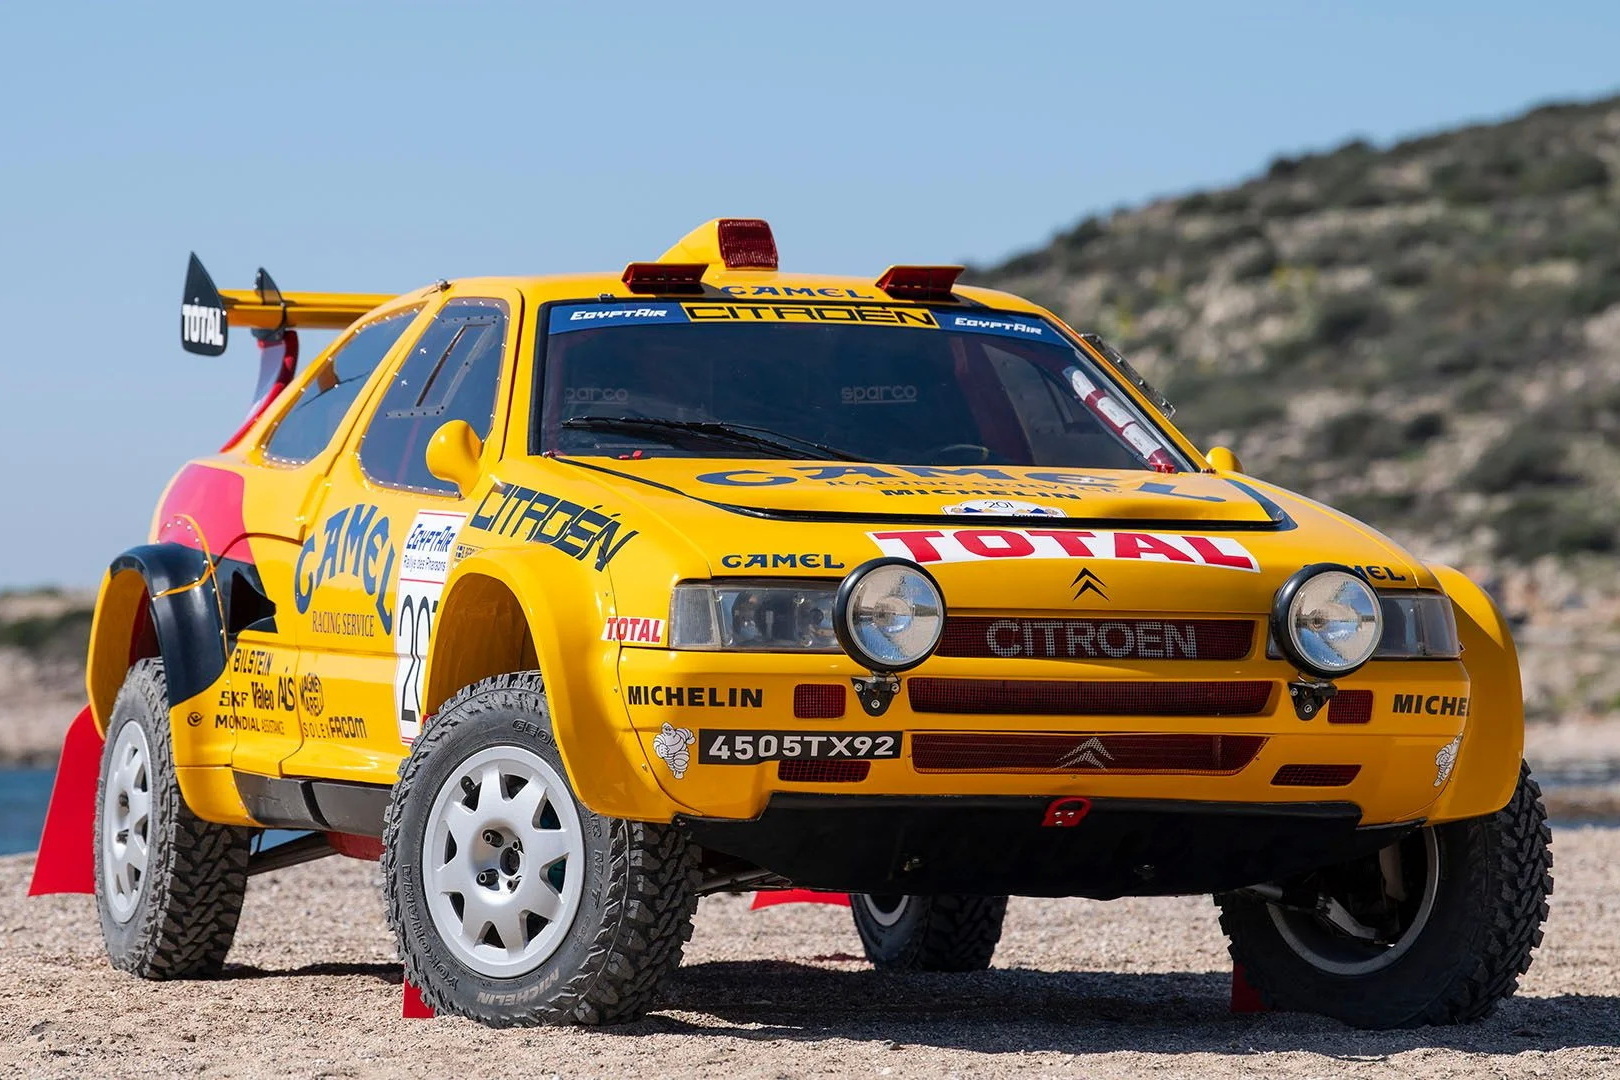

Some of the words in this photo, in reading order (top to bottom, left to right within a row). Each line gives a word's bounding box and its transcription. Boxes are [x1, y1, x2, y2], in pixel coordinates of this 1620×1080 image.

[721, 285, 875, 299] CAMEL
[182, 303, 224, 346] TOTAL
[841, 385, 917, 403] sparco
[696, 466, 1227, 502] CAMEL
[880, 489, 1082, 500] MICHELIN
[984, 501, 1014, 509] 201
[721, 553, 845, 569] CAMEL
[872, 530, 1254, 569] TOTAL
[294, 504, 396, 636] CAMEL
[312, 611, 341, 635] RACING
[342, 613, 375, 637] SERVICE
[606, 617, 660, 642] TOTAL
[986, 619, 1197, 658] CITROEN
[234, 649, 274, 676] BILSTEIN
[399, 594, 438, 722] 20
[219, 691, 249, 708] SKF
[251, 682, 275, 711] Valeo
[627, 685, 763, 708] MICHELIN
[215, 714, 260, 732] MONDIAL
[708, 735, 895, 760] 4505TX92
[402, 864, 459, 991] YOKOHAMA
[476, 968, 560, 1006] MICHELIN
